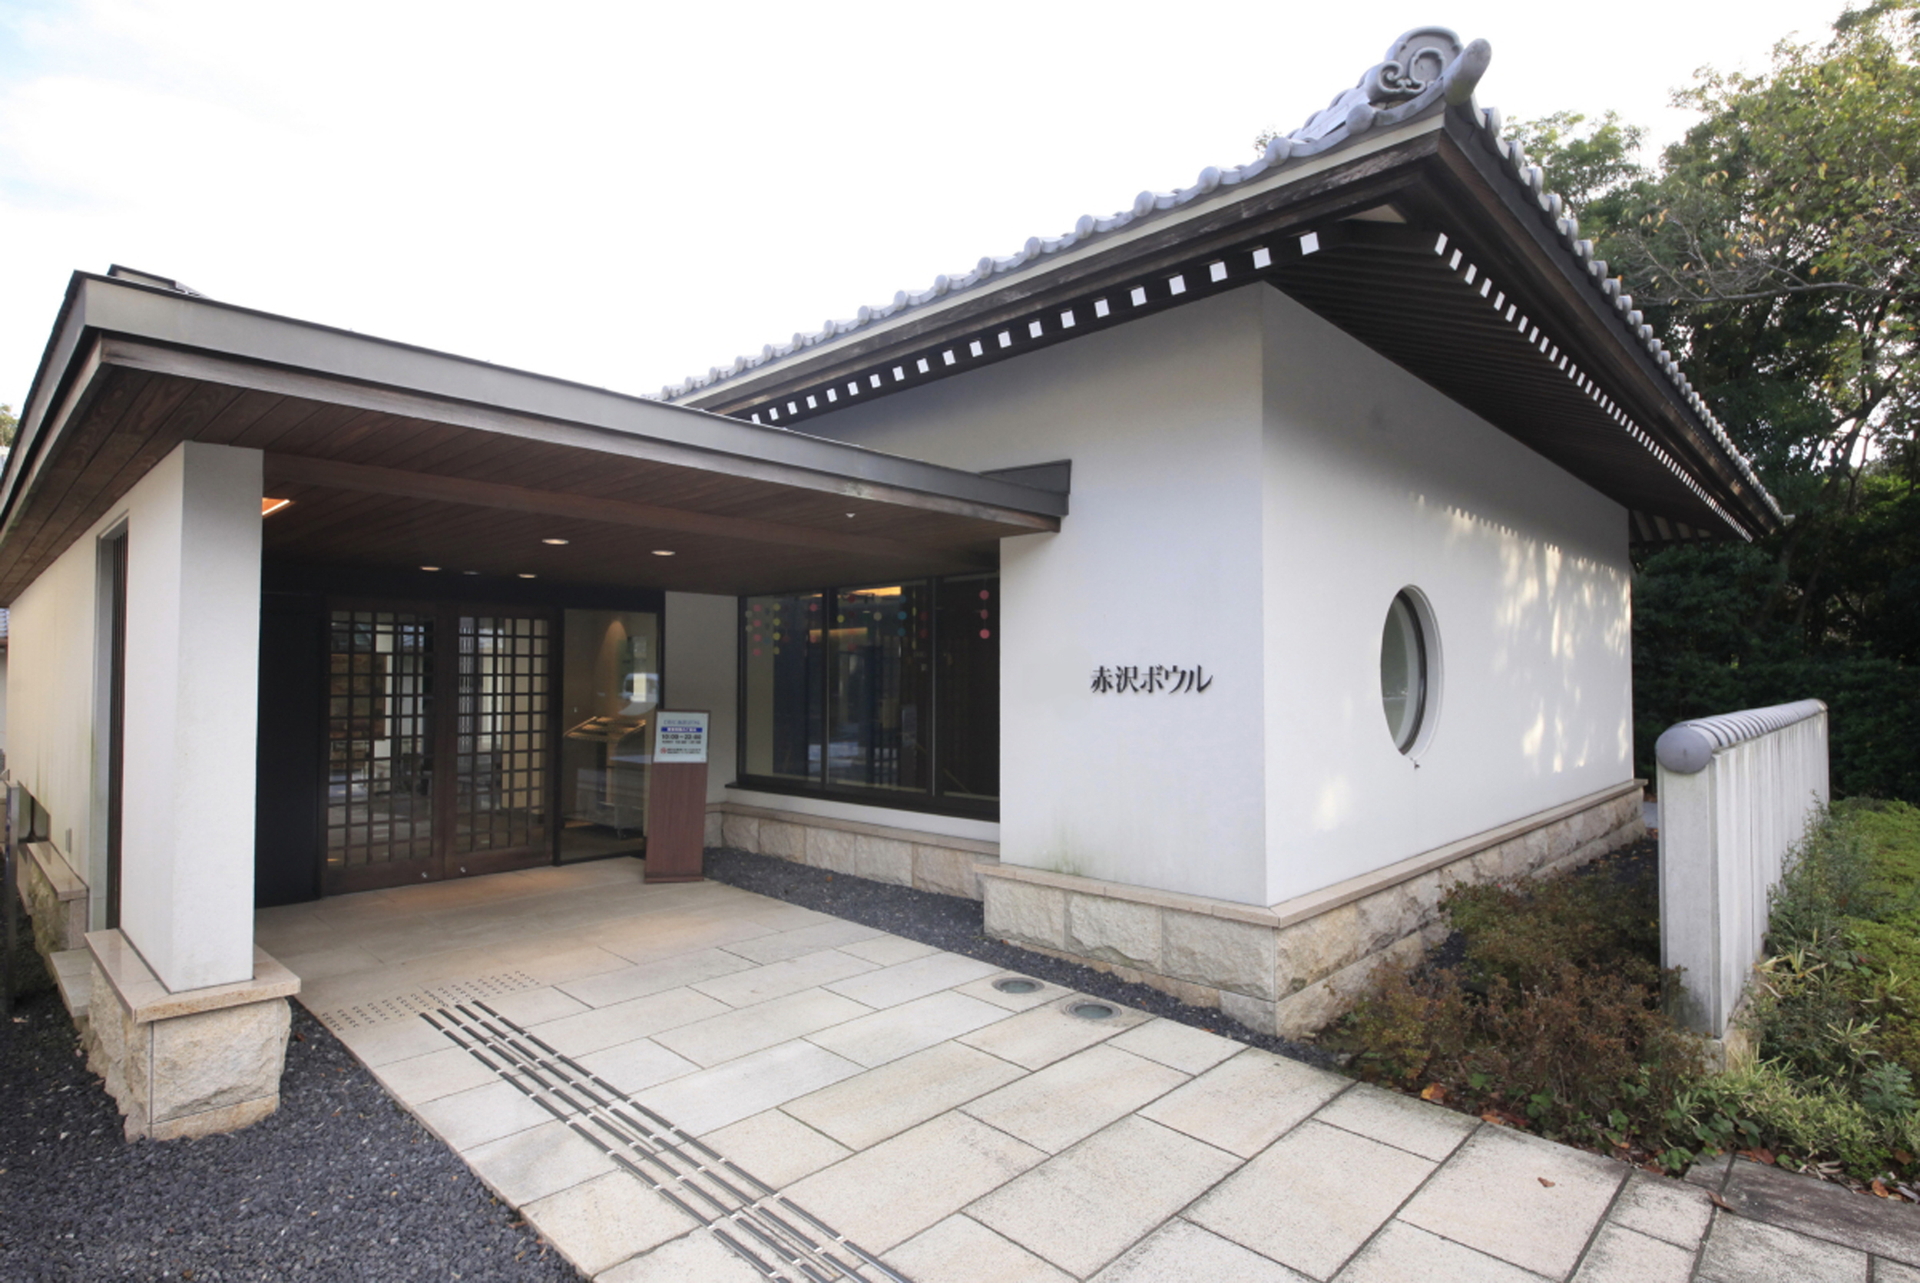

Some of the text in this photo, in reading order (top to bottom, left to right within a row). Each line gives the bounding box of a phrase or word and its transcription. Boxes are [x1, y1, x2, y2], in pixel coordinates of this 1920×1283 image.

[1090, 664, 1213, 694] 赤沢ボウル
